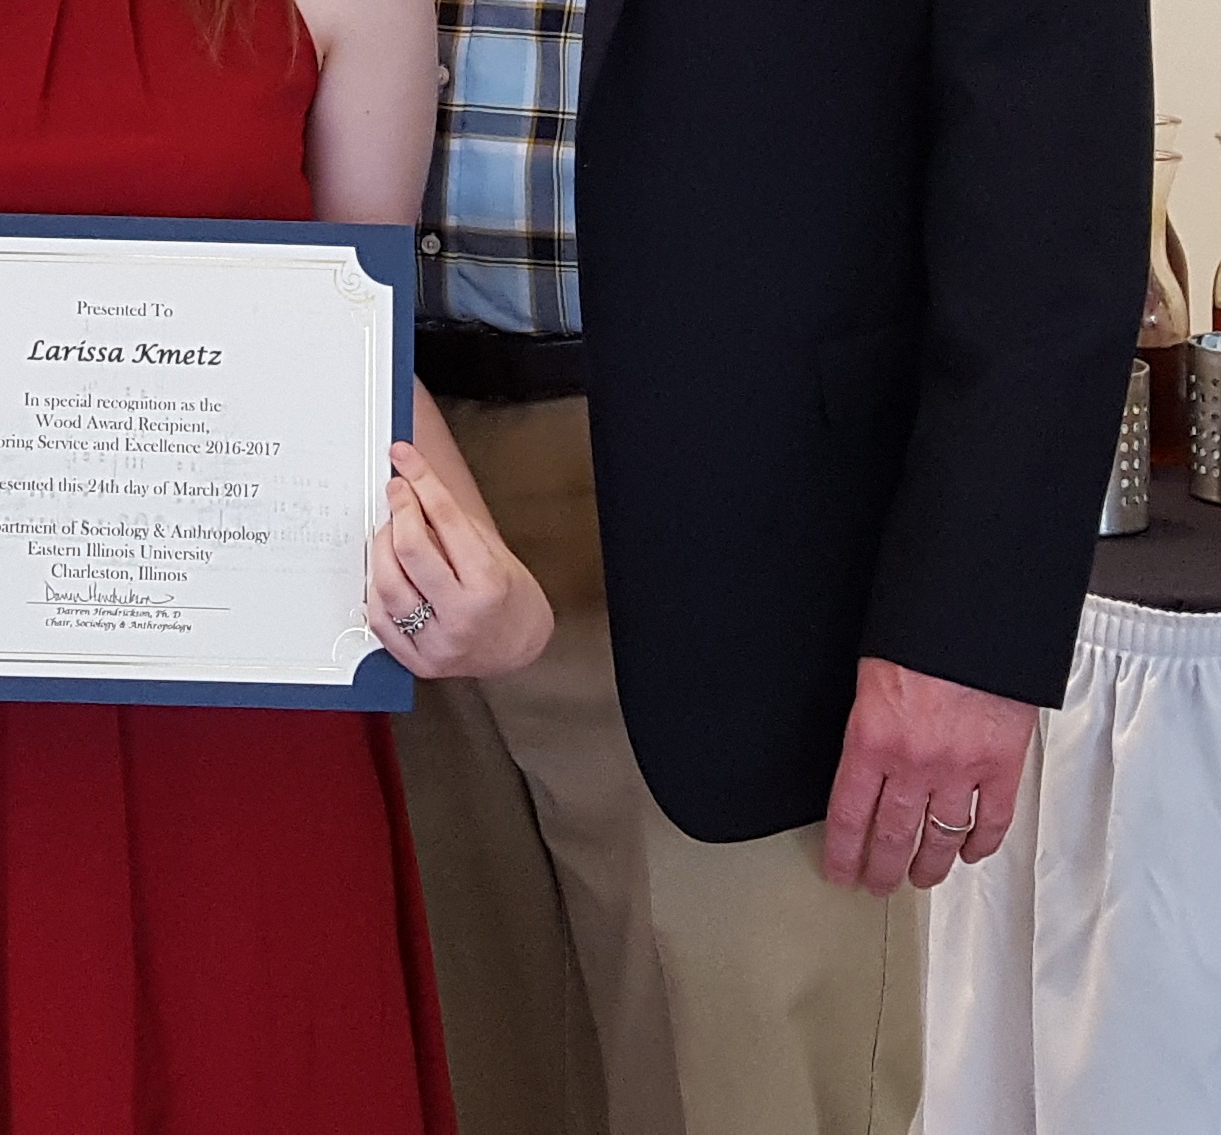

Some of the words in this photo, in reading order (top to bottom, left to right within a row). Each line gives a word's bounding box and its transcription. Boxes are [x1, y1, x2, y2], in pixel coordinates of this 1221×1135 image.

[76, 300, 147, 317] Presented
[151, 302, 174, 318] To
[26, 339, 125, 363] Larissa
[131, 343, 223, 366] Kmetz
[24, 392, 40, 407] In
[44, 393, 92, 411] special
[97, 396, 176, 413] recognition
[180, 401, 195, 412] as
[200, 397, 222, 413] the
[36, 414, 82, 429] Wood
[87, 415, 133, 431] Award
[138, 416, 210, 435] Recipient,
[37, 434, 89, 451] Service
[93, 437, 119, 452] and
[125, 437, 201, 454] Excellence
[205, 440, 281, 456] 2016-2017
[58, 477, 83, 493] this
[88, 478, 120, 494] 24th
[123, 479, 149, 498] day
[153, 480, 170, 495] of
[173, 481, 219, 497] March
[224, 482, 260, 498] 2017
[61, 520, 78, 535] of
[80, 520, 149, 540] Sociology
[153, 523, 166, 538] &
[170, 524, 271, 544] Anthropology
[28, 540, 81, 556] Eastern
[86, 542, 135, 558] Illinois
[140, 544, 213, 564] University
[51, 563, 134, 581] Charleston,
[138, 566, 188, 582] Illinois
[56, 607, 90, 616] Darren
[92, 607, 152, 618] Hendrickson,
[45, 618, 73, 628] Chair,
[75, 620, 116, 631] Sociology
[119, 620, 125, 628] &
[128, 621, 192, 633] Anthropology
